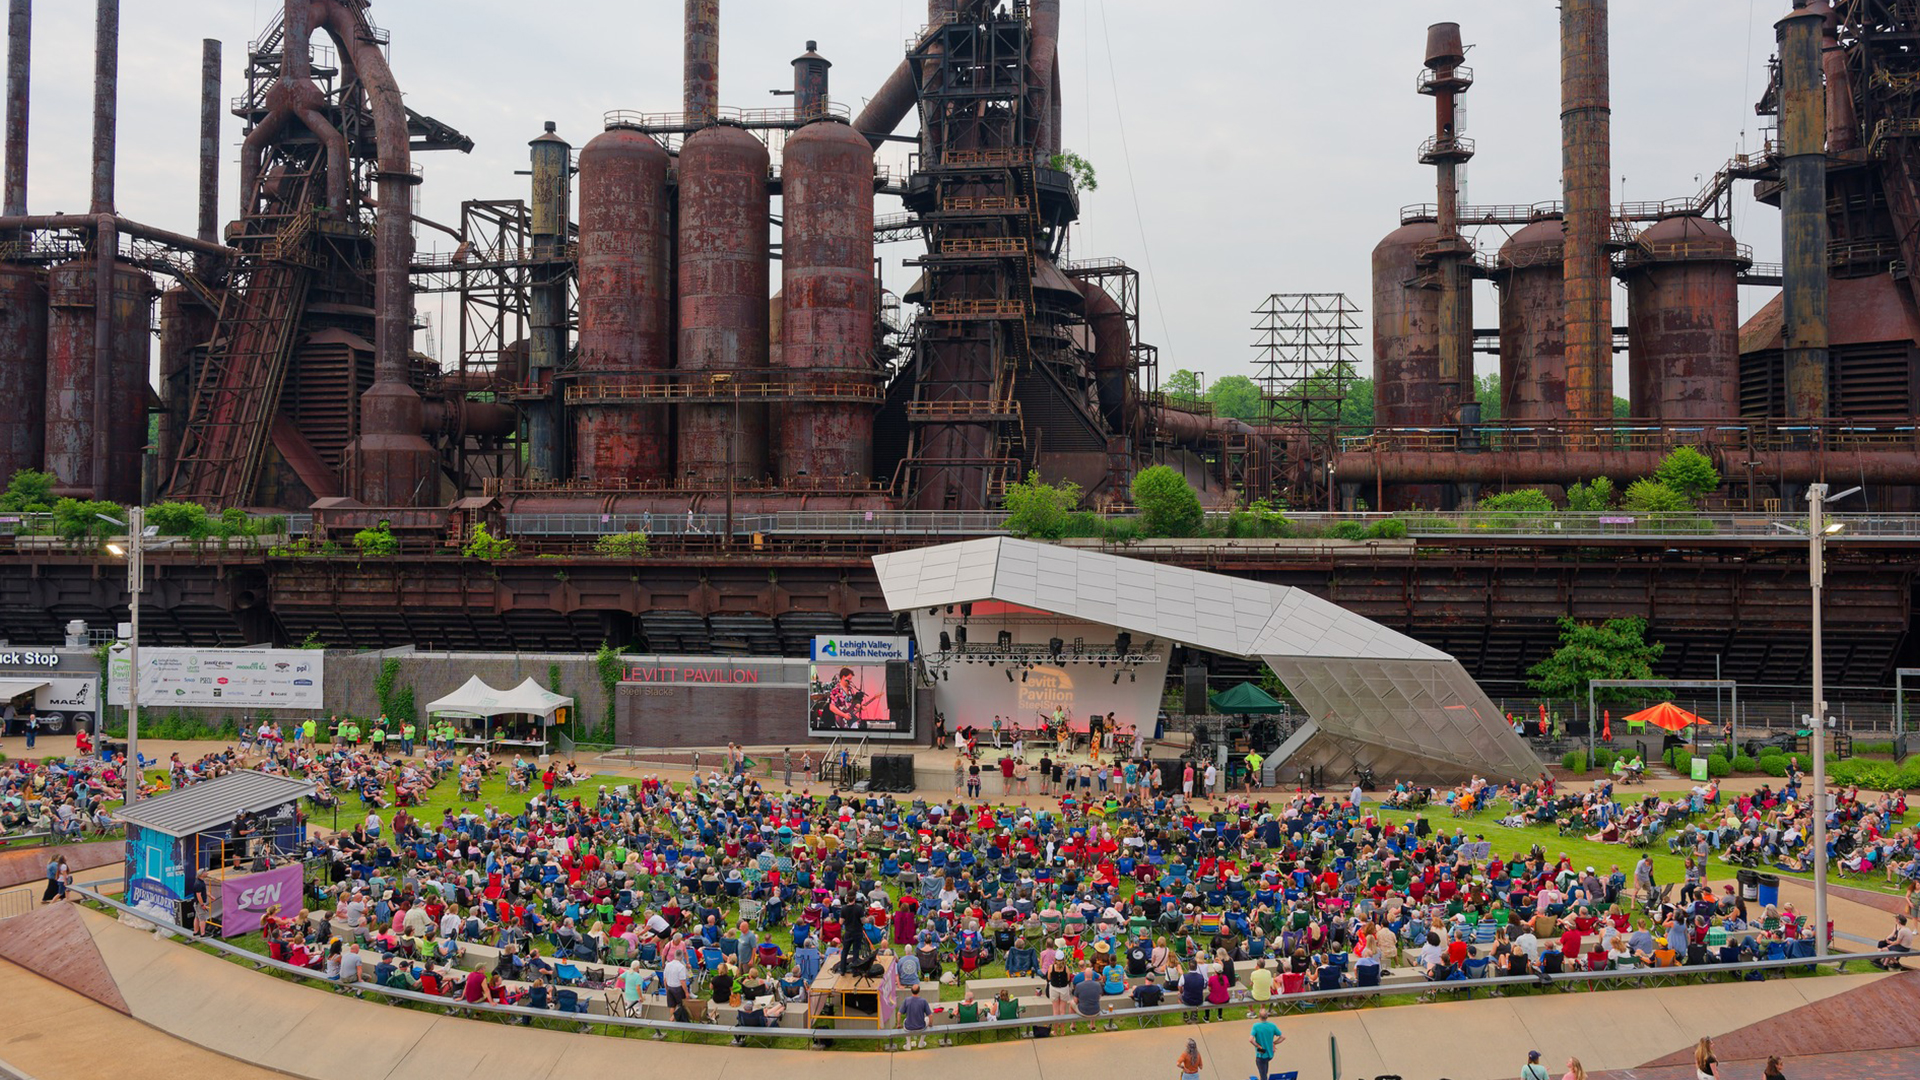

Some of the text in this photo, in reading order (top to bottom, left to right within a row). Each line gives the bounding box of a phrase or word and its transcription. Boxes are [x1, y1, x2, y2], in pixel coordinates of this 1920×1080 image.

[840, 640, 892, 649] Lehigh Valley
[0, 651, 58, 667] ck Stop
[840, 649, 902, 658] Health Network
[622, 667, 758, 683] LEVITT PAVILION
[620, 687, 673, 696] Steel Stacks
[1019, 687, 1073, 700] Pavilion
[238, 882, 282, 910] SEN
